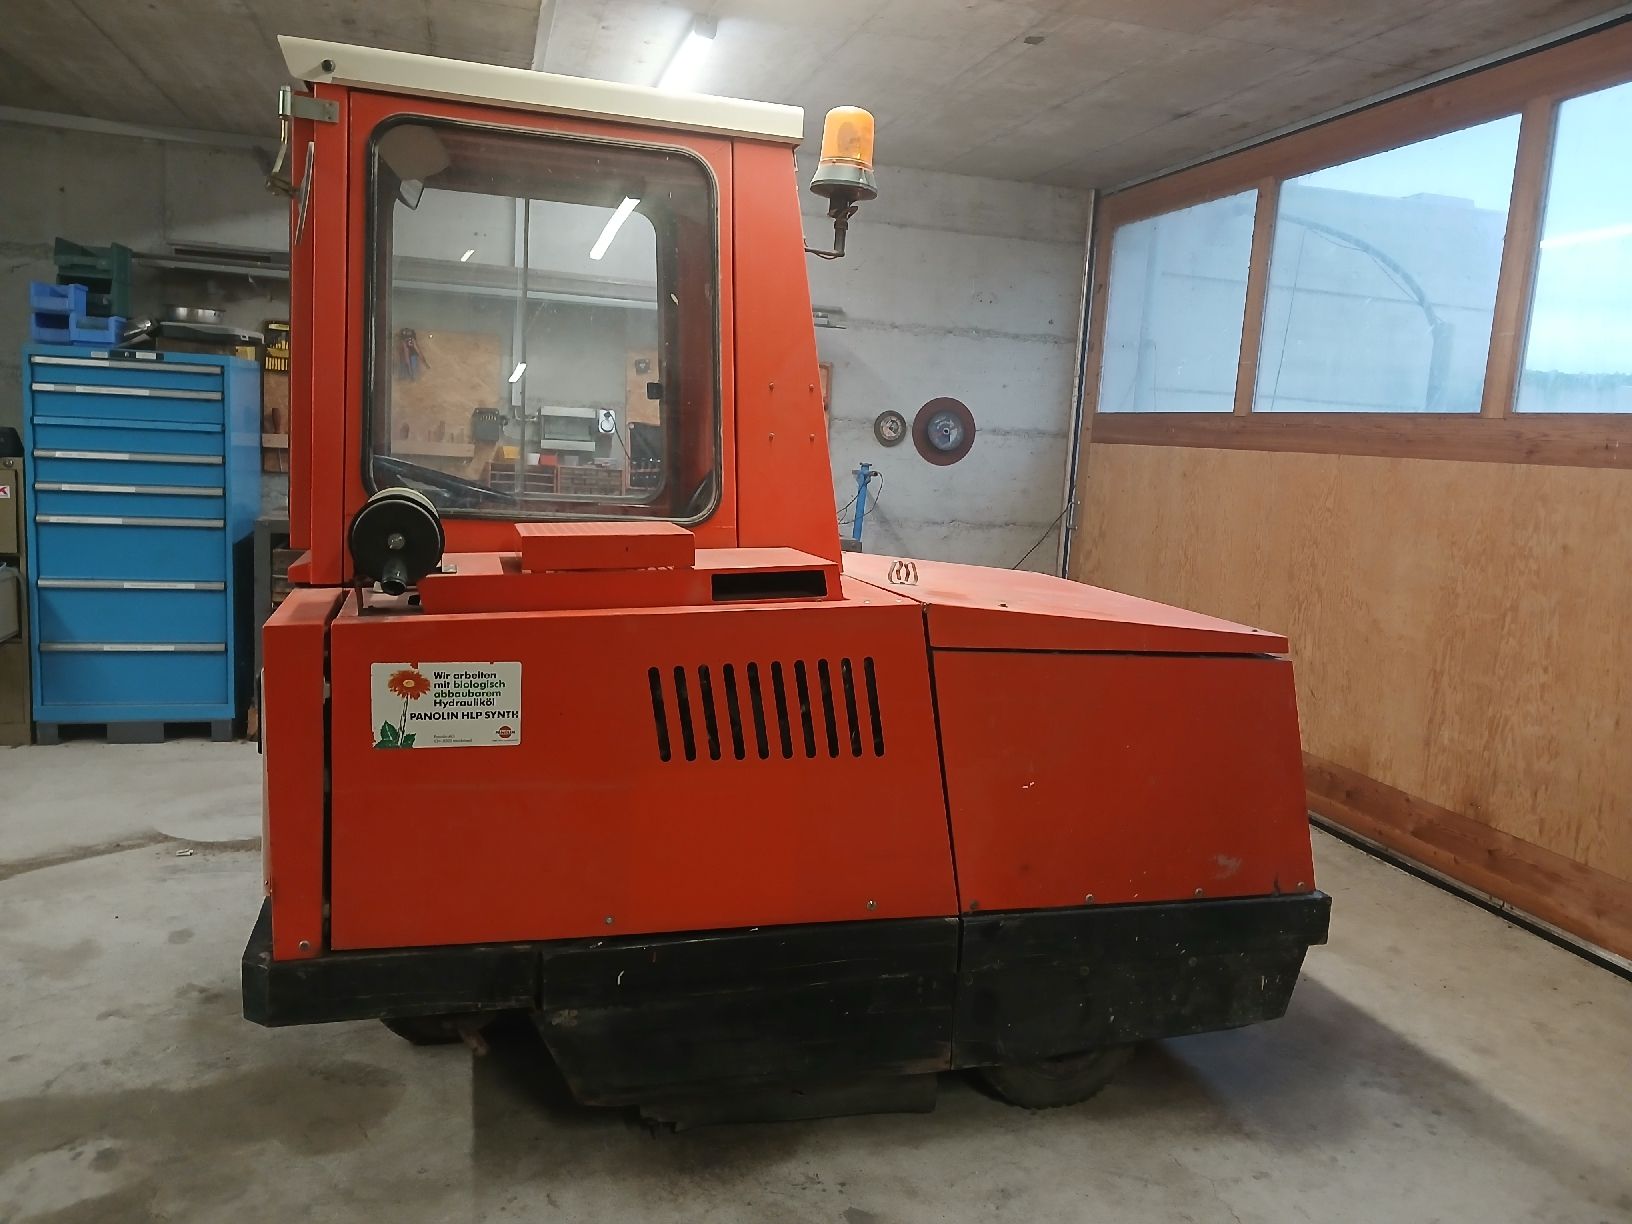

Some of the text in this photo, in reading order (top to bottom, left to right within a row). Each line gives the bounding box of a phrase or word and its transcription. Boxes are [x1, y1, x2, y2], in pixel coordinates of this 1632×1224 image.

[433, 670, 497, 680] Wir arbeiten
[433, 679, 506, 691] mit biologisch
[433, 689, 502, 699] abbaubarem
[433, 697, 495, 709] Hydrauliköl
[409, 710, 519, 721] PANOLIN HLP SYNTH
